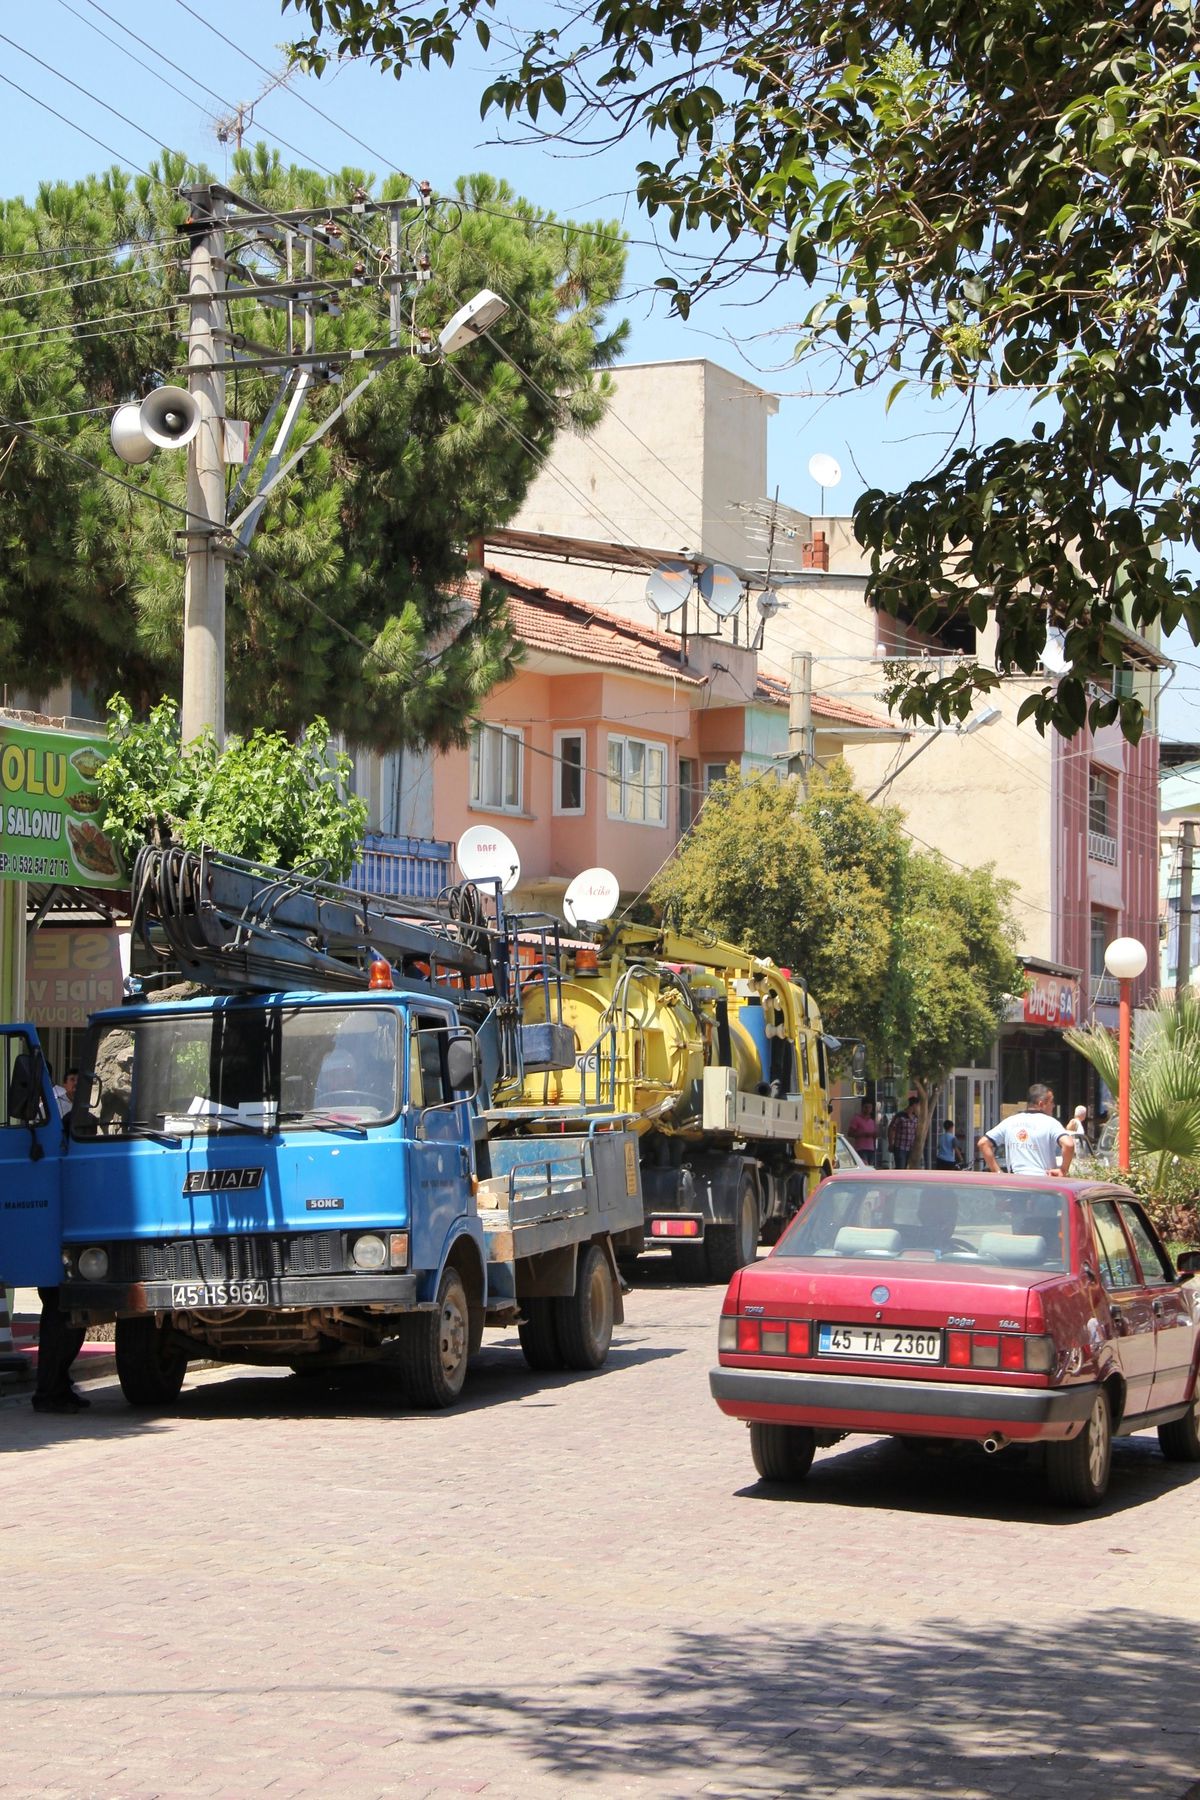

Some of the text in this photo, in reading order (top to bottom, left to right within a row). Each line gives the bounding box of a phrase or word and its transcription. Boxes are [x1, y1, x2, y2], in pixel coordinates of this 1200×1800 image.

[0, 743, 67, 798] OLU
[7, 806, 61, 840] SALONU
[12, 855, 18, 873] 0
[19, 855, 33, 875] 532
[34, 856, 48, 876] 547
[49, 858, 58, 877] 27
[59, 859, 69, 878] 76
[190, 1171, 257, 1188] FIAT
[174, 1283, 266, 1306] 45 HS 964
[831, 1329, 852, 1350] 45
[864, 1331, 883, 1353] TA
[893, 1333, 936, 1356] 2360
